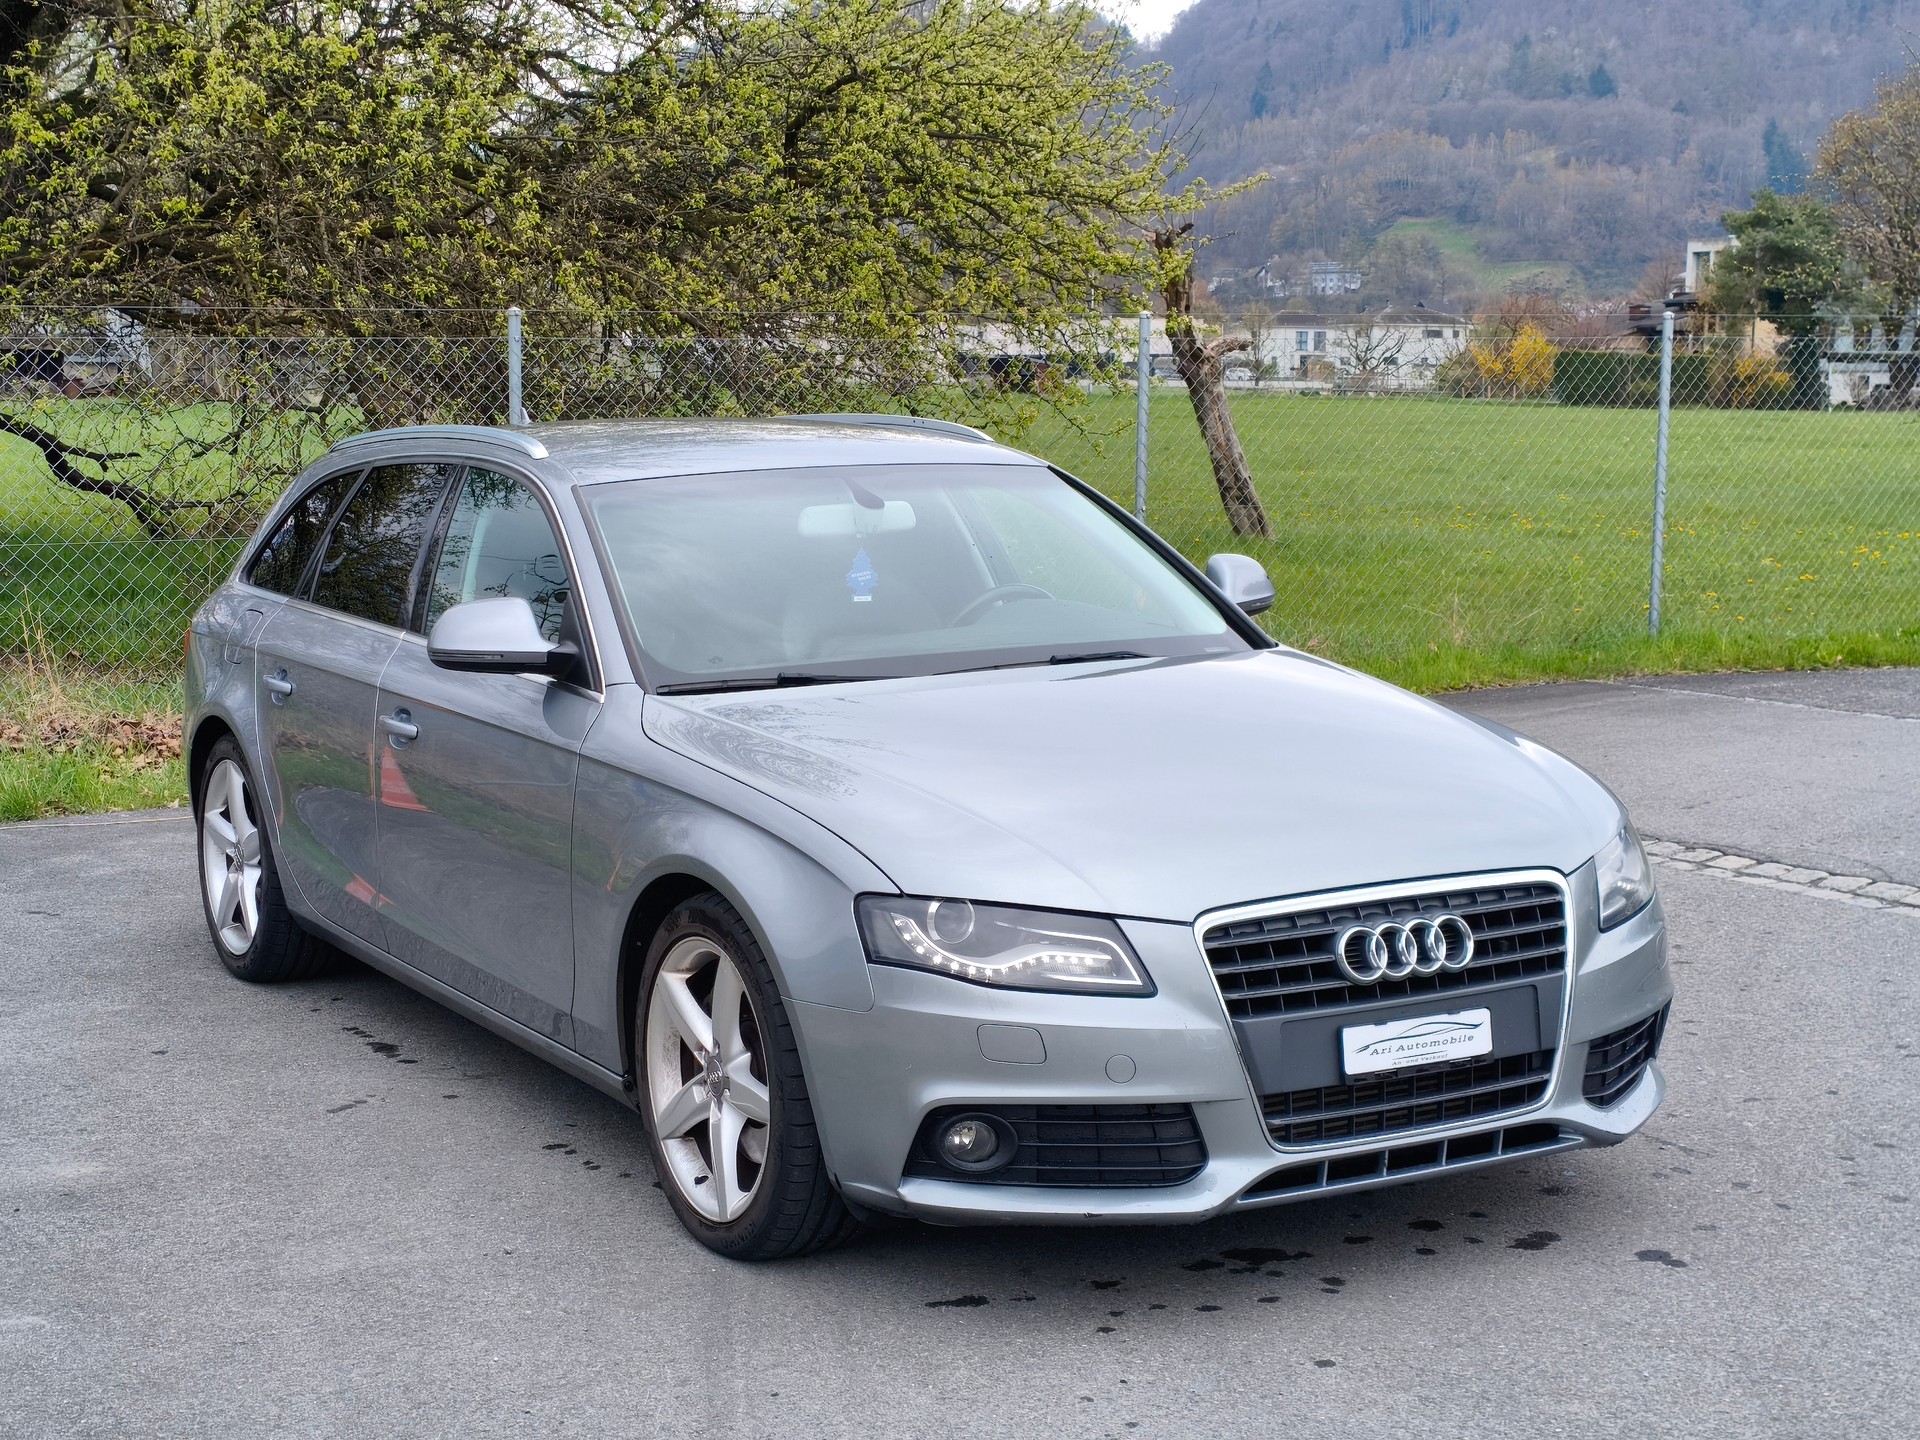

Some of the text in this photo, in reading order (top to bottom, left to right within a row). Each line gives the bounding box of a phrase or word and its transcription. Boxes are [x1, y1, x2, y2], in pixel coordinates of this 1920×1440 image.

[1369, 1034, 1474, 1056] Ari Automobile
[1420, 1053, 1449, 1061] Verkauf
